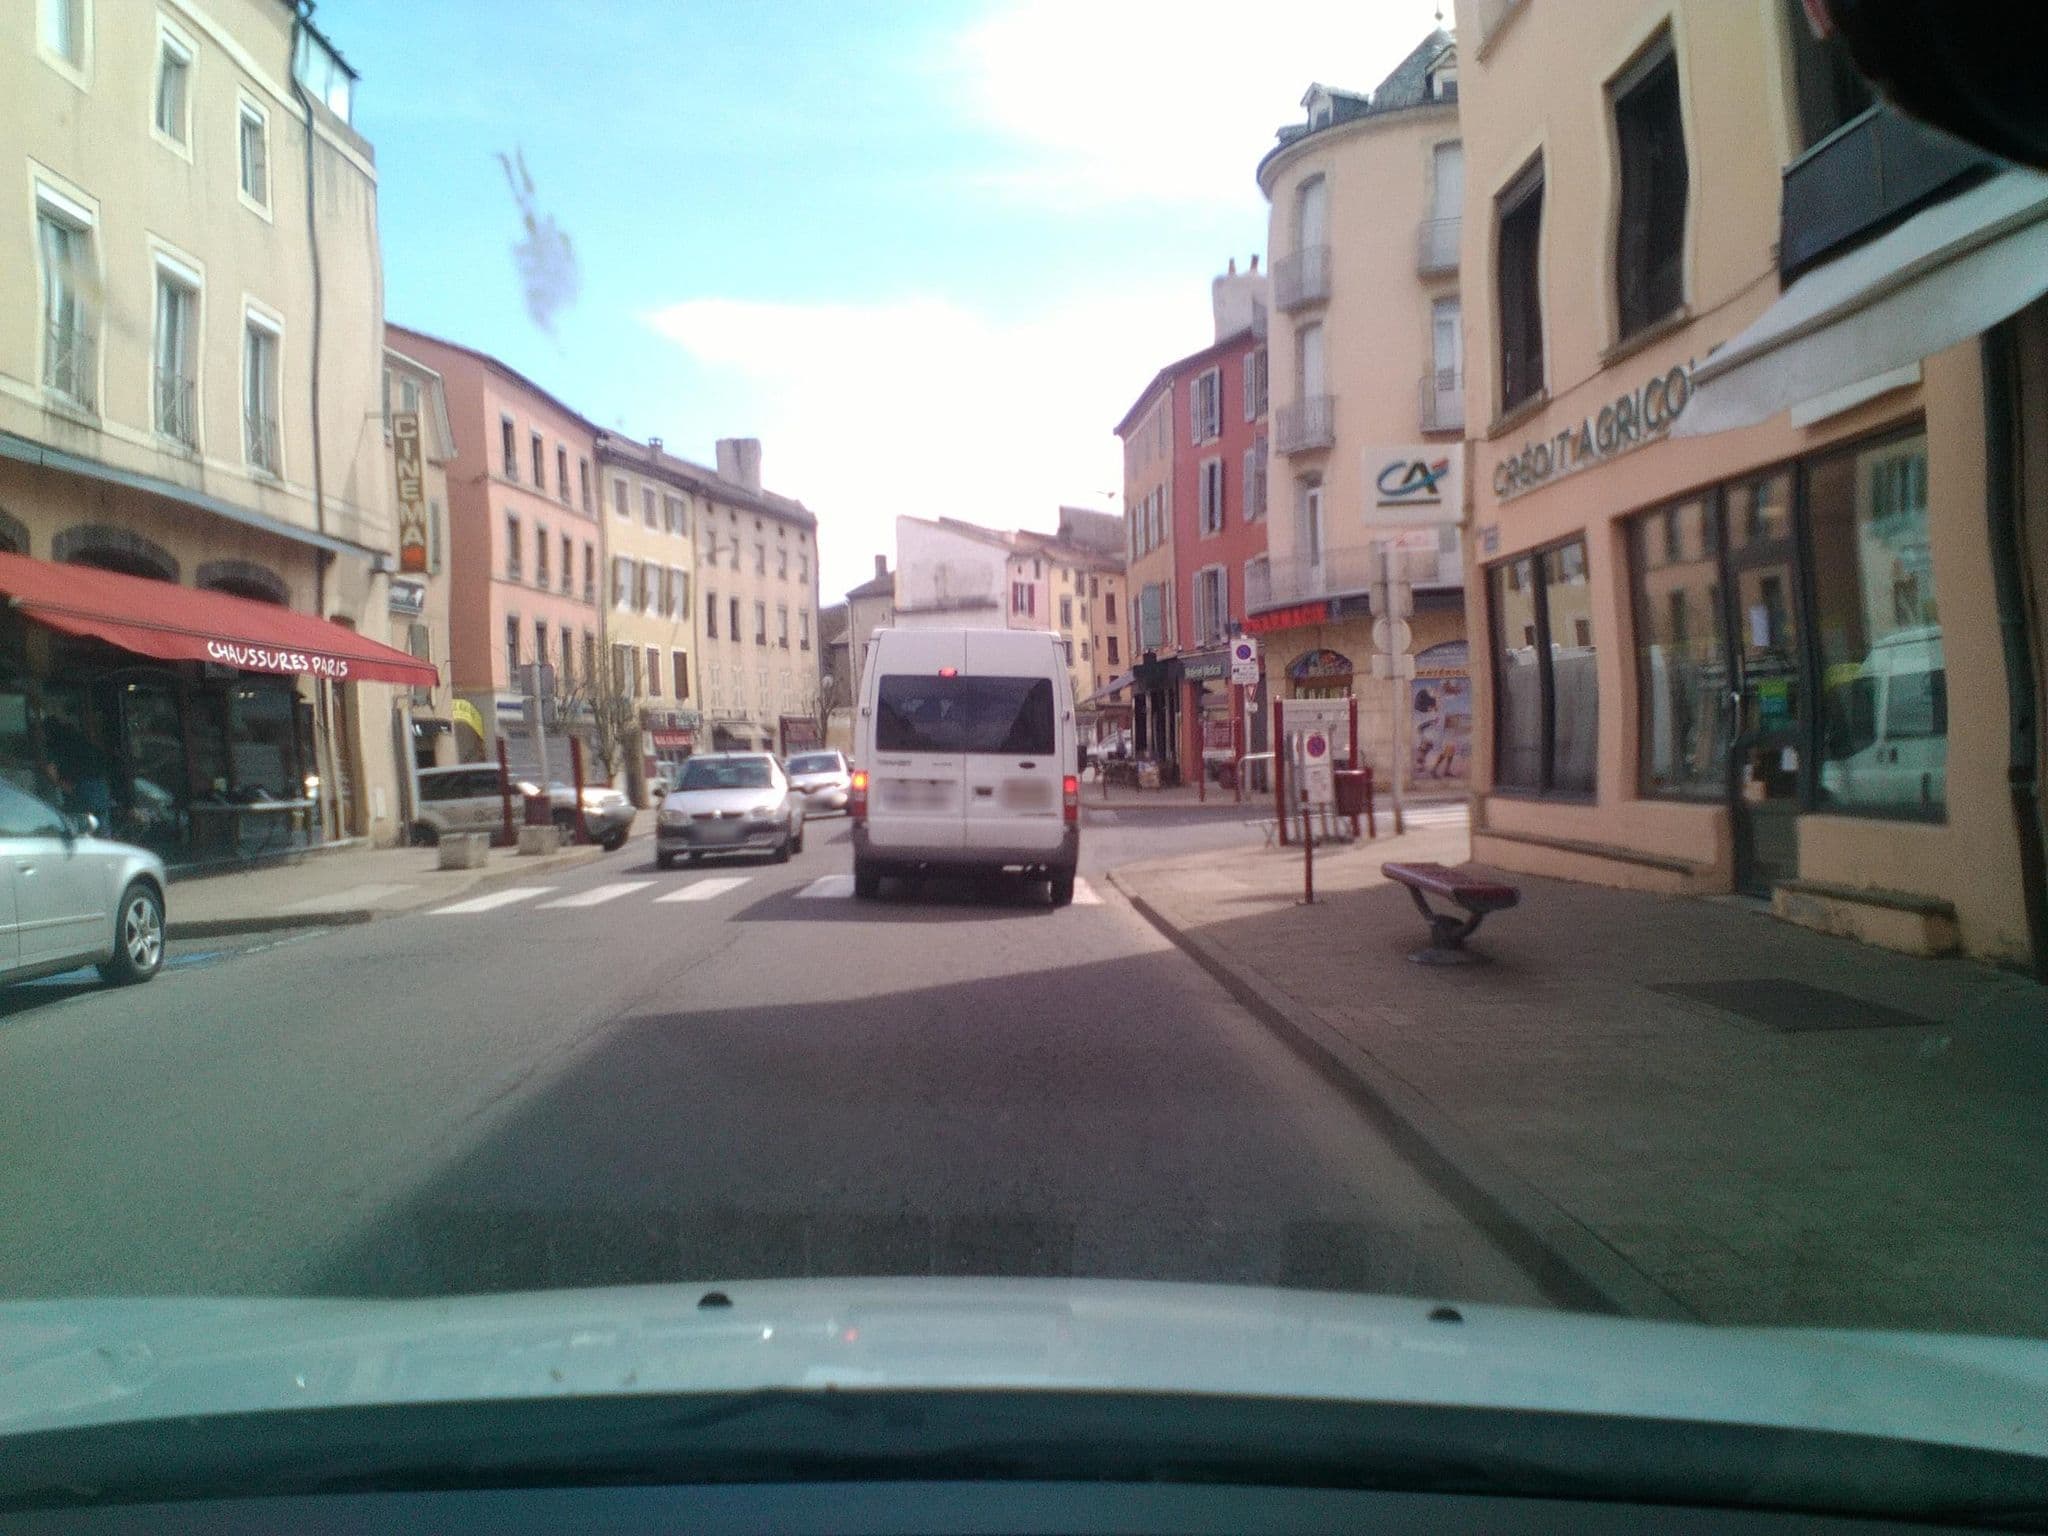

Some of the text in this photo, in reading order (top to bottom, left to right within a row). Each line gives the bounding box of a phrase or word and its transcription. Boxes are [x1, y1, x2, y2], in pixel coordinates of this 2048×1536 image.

[1578, 342, 1722, 456] AGRICO
[394, 415, 426, 547] CINEMA
[207, 641, 348, 677] CHAUSSURES PARIS
